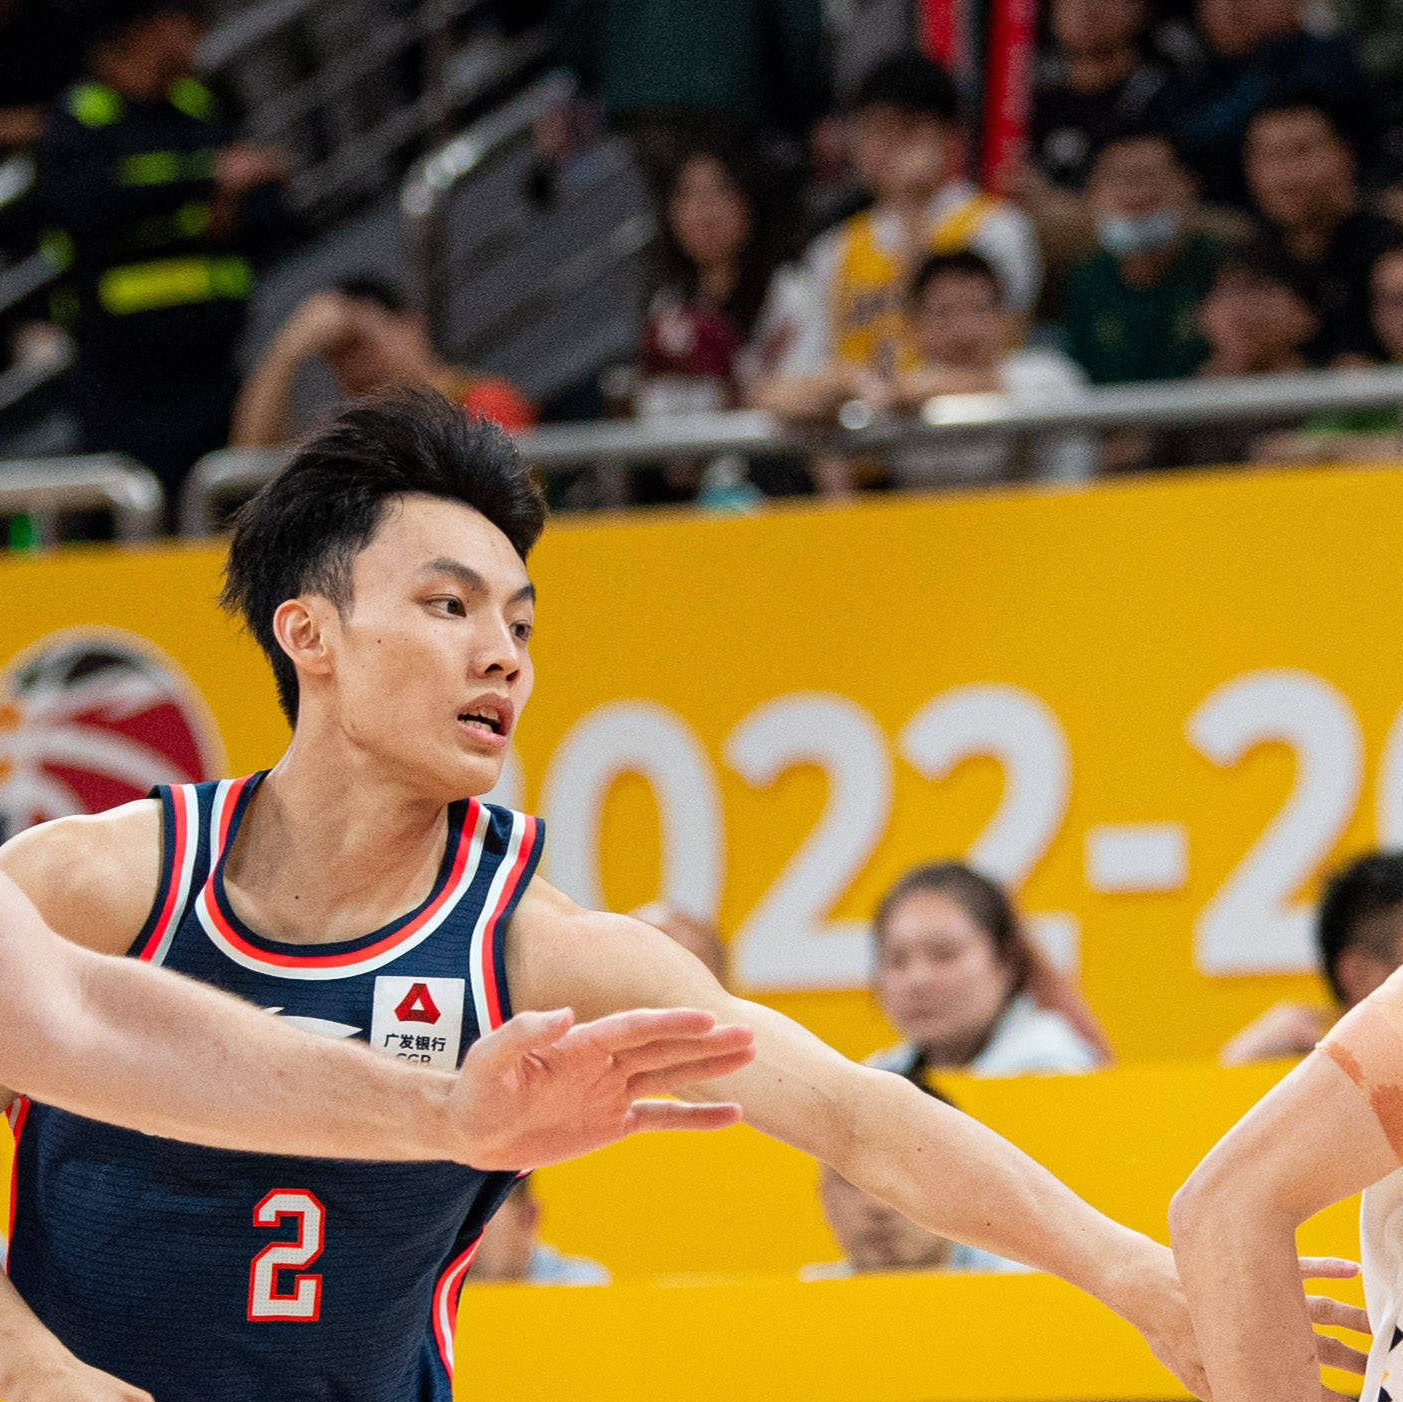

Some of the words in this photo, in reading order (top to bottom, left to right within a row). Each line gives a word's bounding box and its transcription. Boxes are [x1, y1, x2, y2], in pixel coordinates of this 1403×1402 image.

[383, 1032, 447, 1052] 广发银行
[246, 1188, 325, 1322] 2
